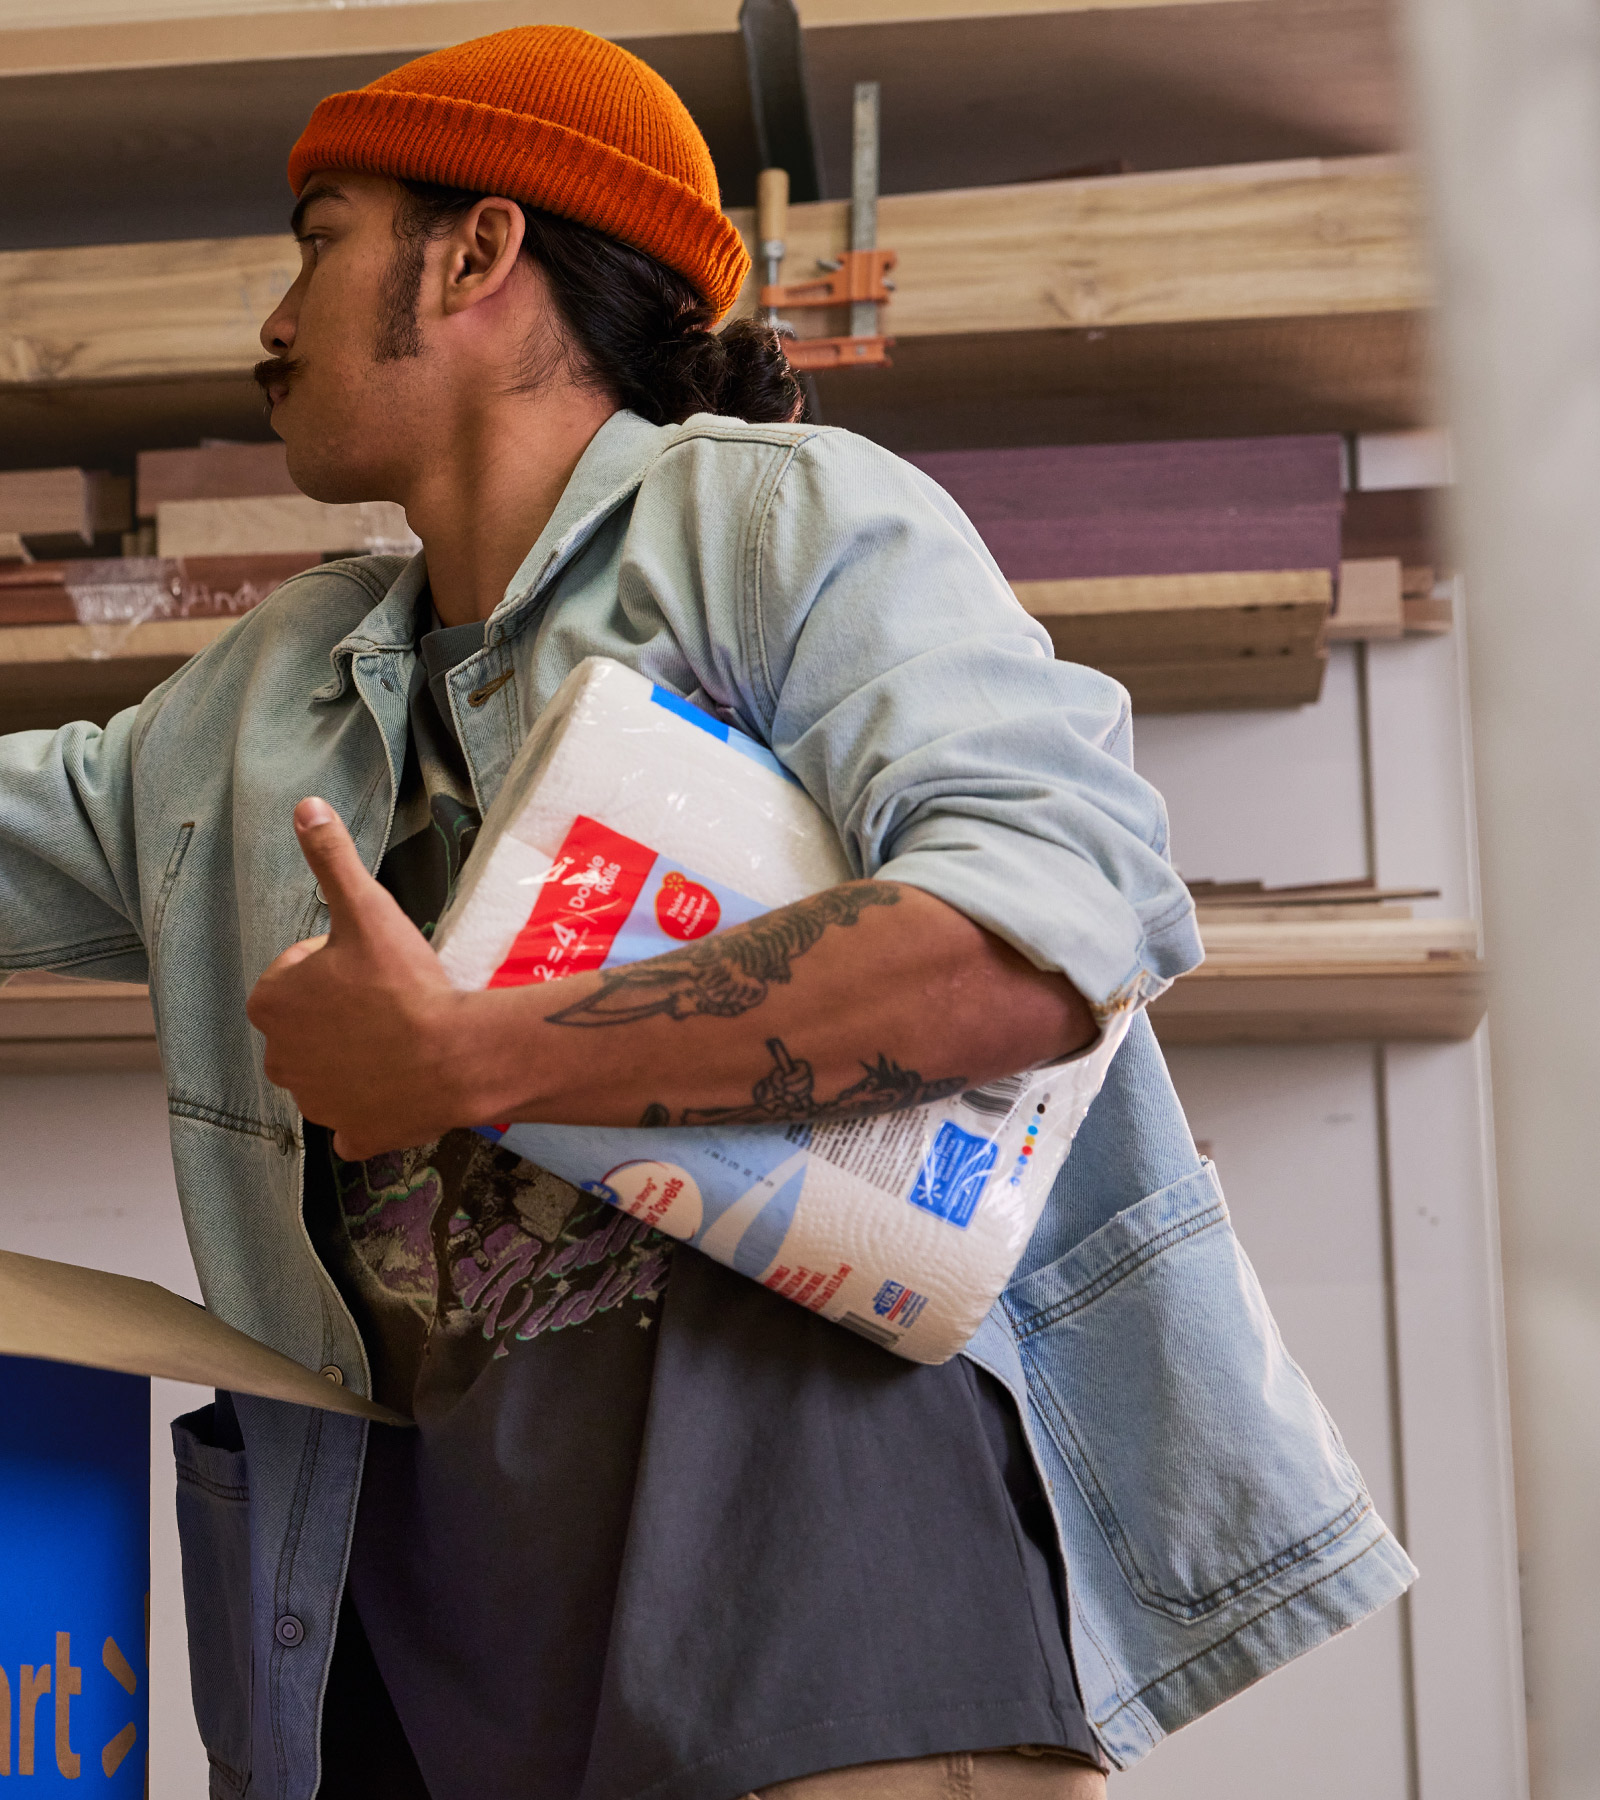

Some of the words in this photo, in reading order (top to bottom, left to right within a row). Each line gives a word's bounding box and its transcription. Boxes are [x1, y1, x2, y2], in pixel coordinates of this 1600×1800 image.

[595, 862, 621, 895] Rolls
[667, 890, 686, 918] Thicker
[681, 895, 697, 915] More
[882, 1281, 903, 1308] USA
